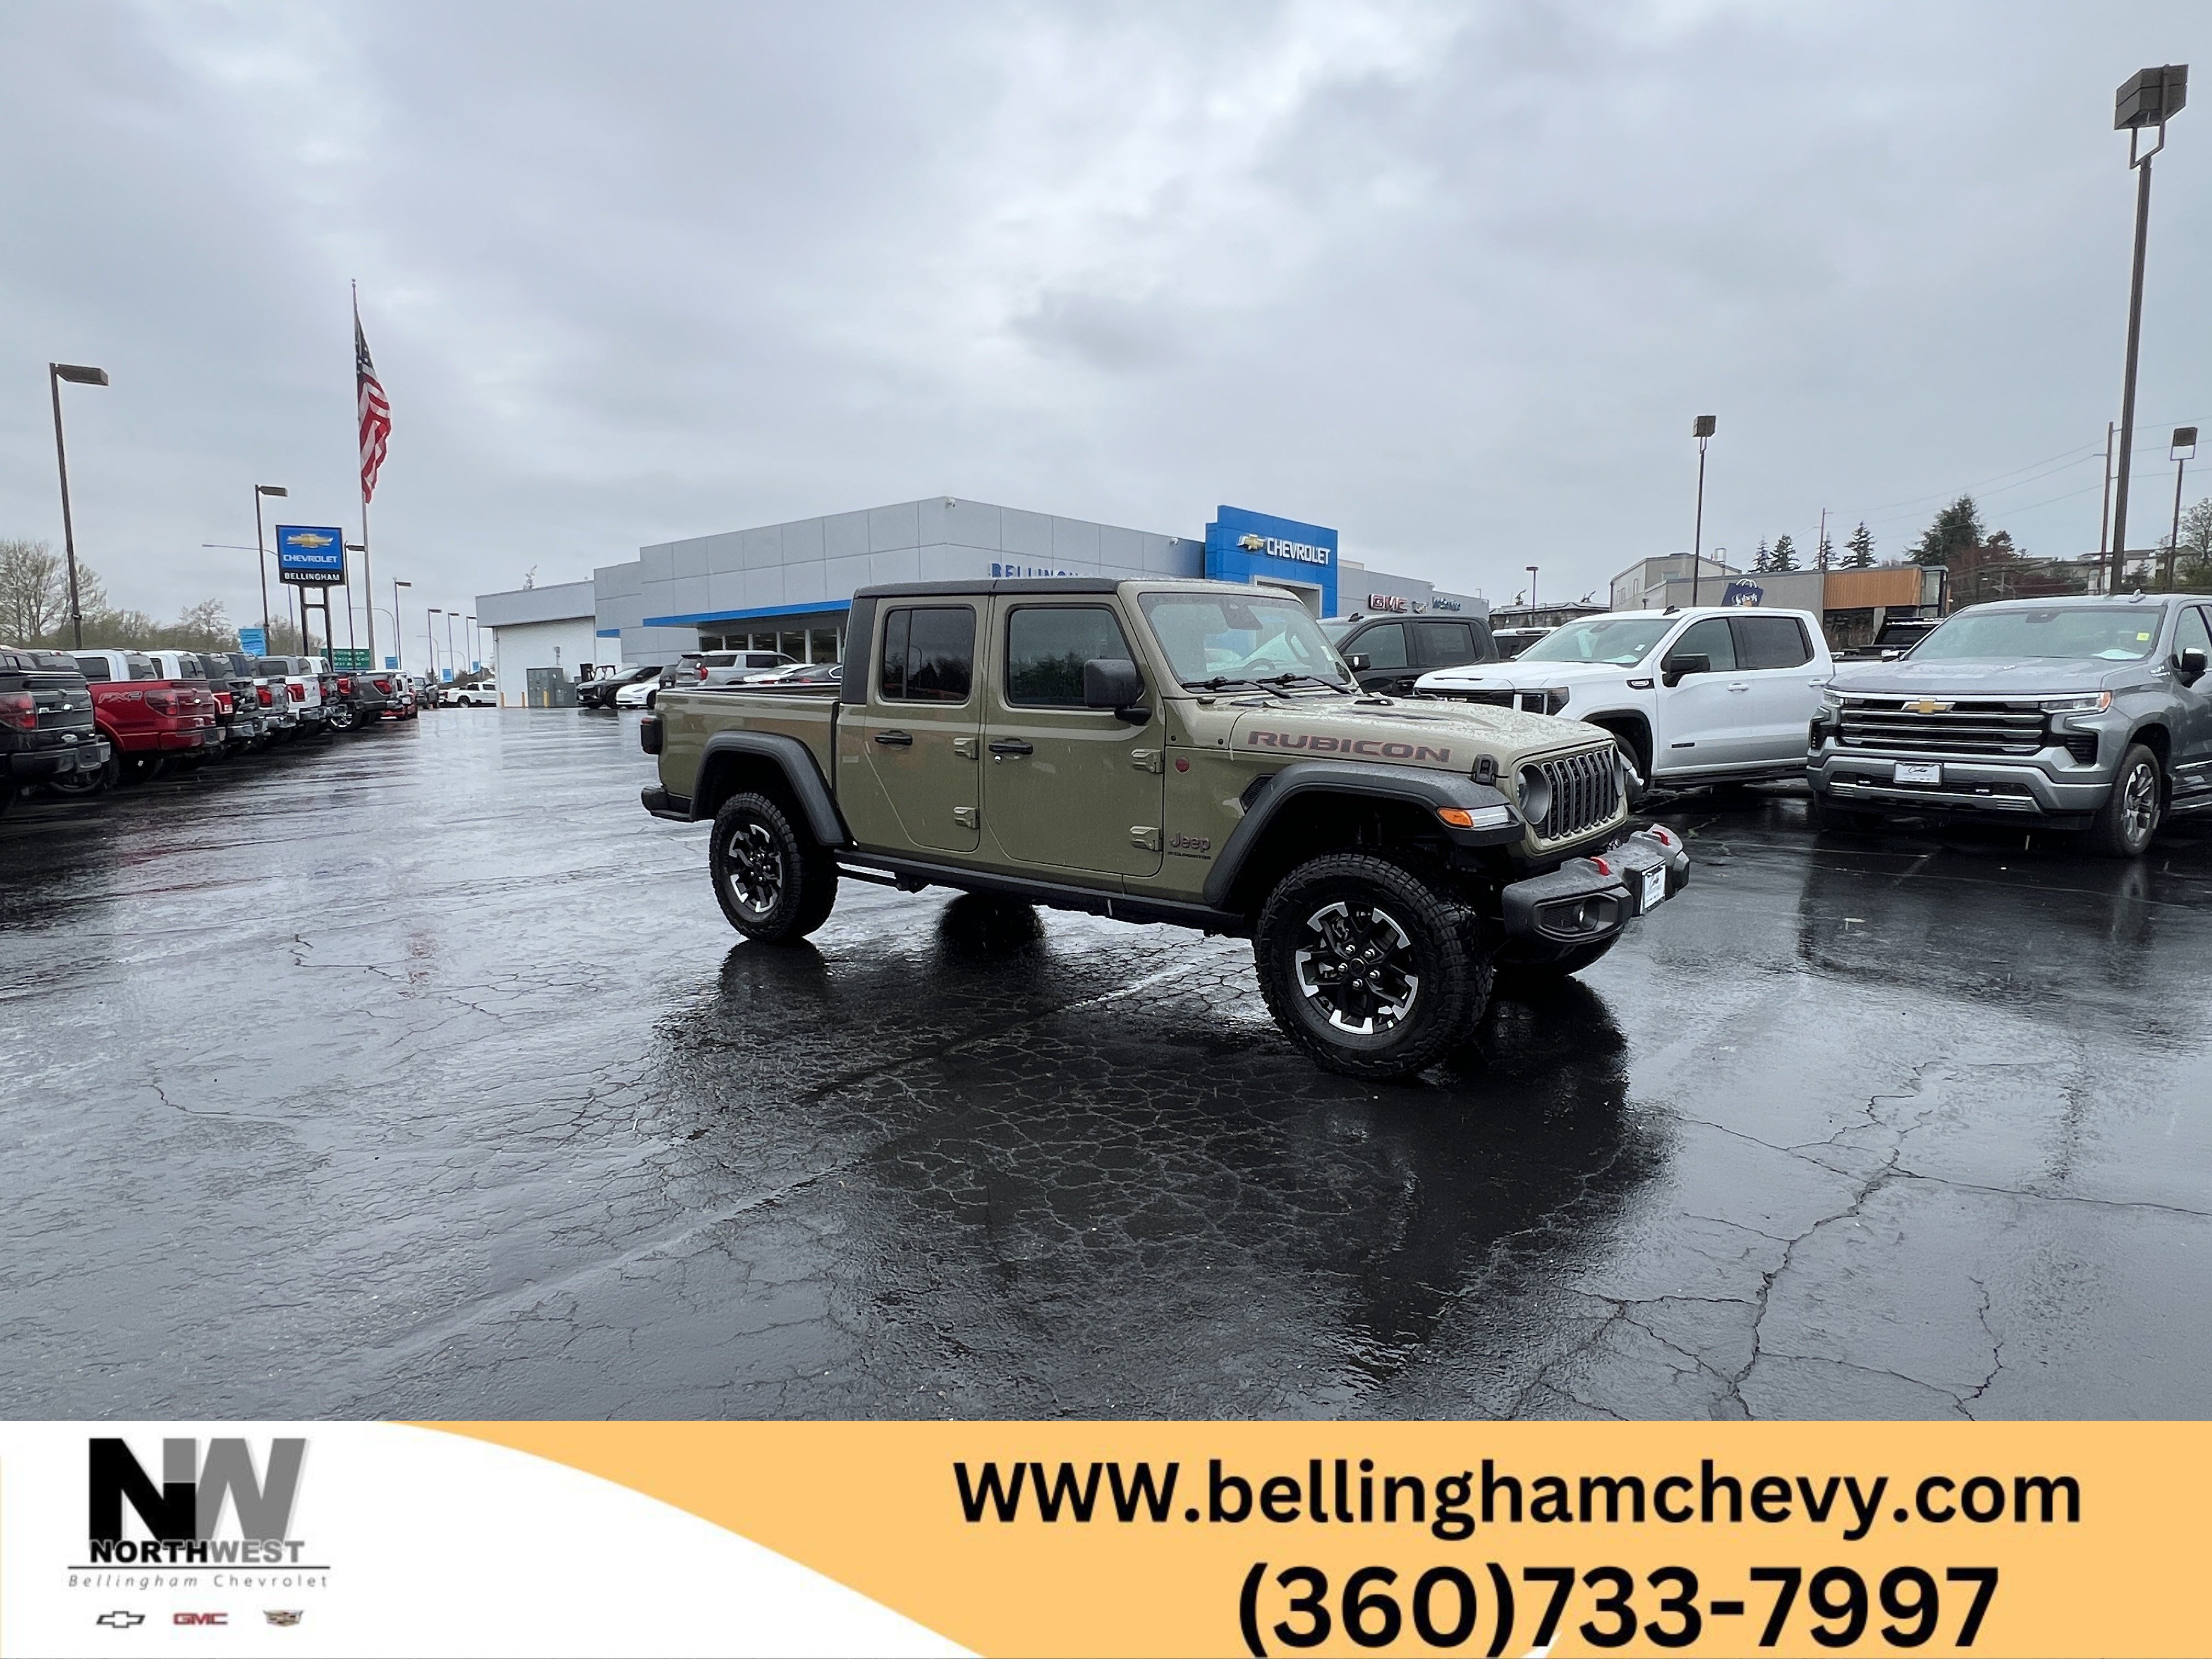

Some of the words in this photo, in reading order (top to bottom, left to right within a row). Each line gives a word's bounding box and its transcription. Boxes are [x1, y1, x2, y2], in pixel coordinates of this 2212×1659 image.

[283, 554, 337, 563] CHEVROLET
[1266, 537, 1331, 566] CHEVROLET
[284, 572, 340, 581] BELLINGHAM
[1369, 594, 1408, 614] GMC
[1248, 731, 1451, 763] RUBICON
[1169, 831, 1211, 853] Jeep
